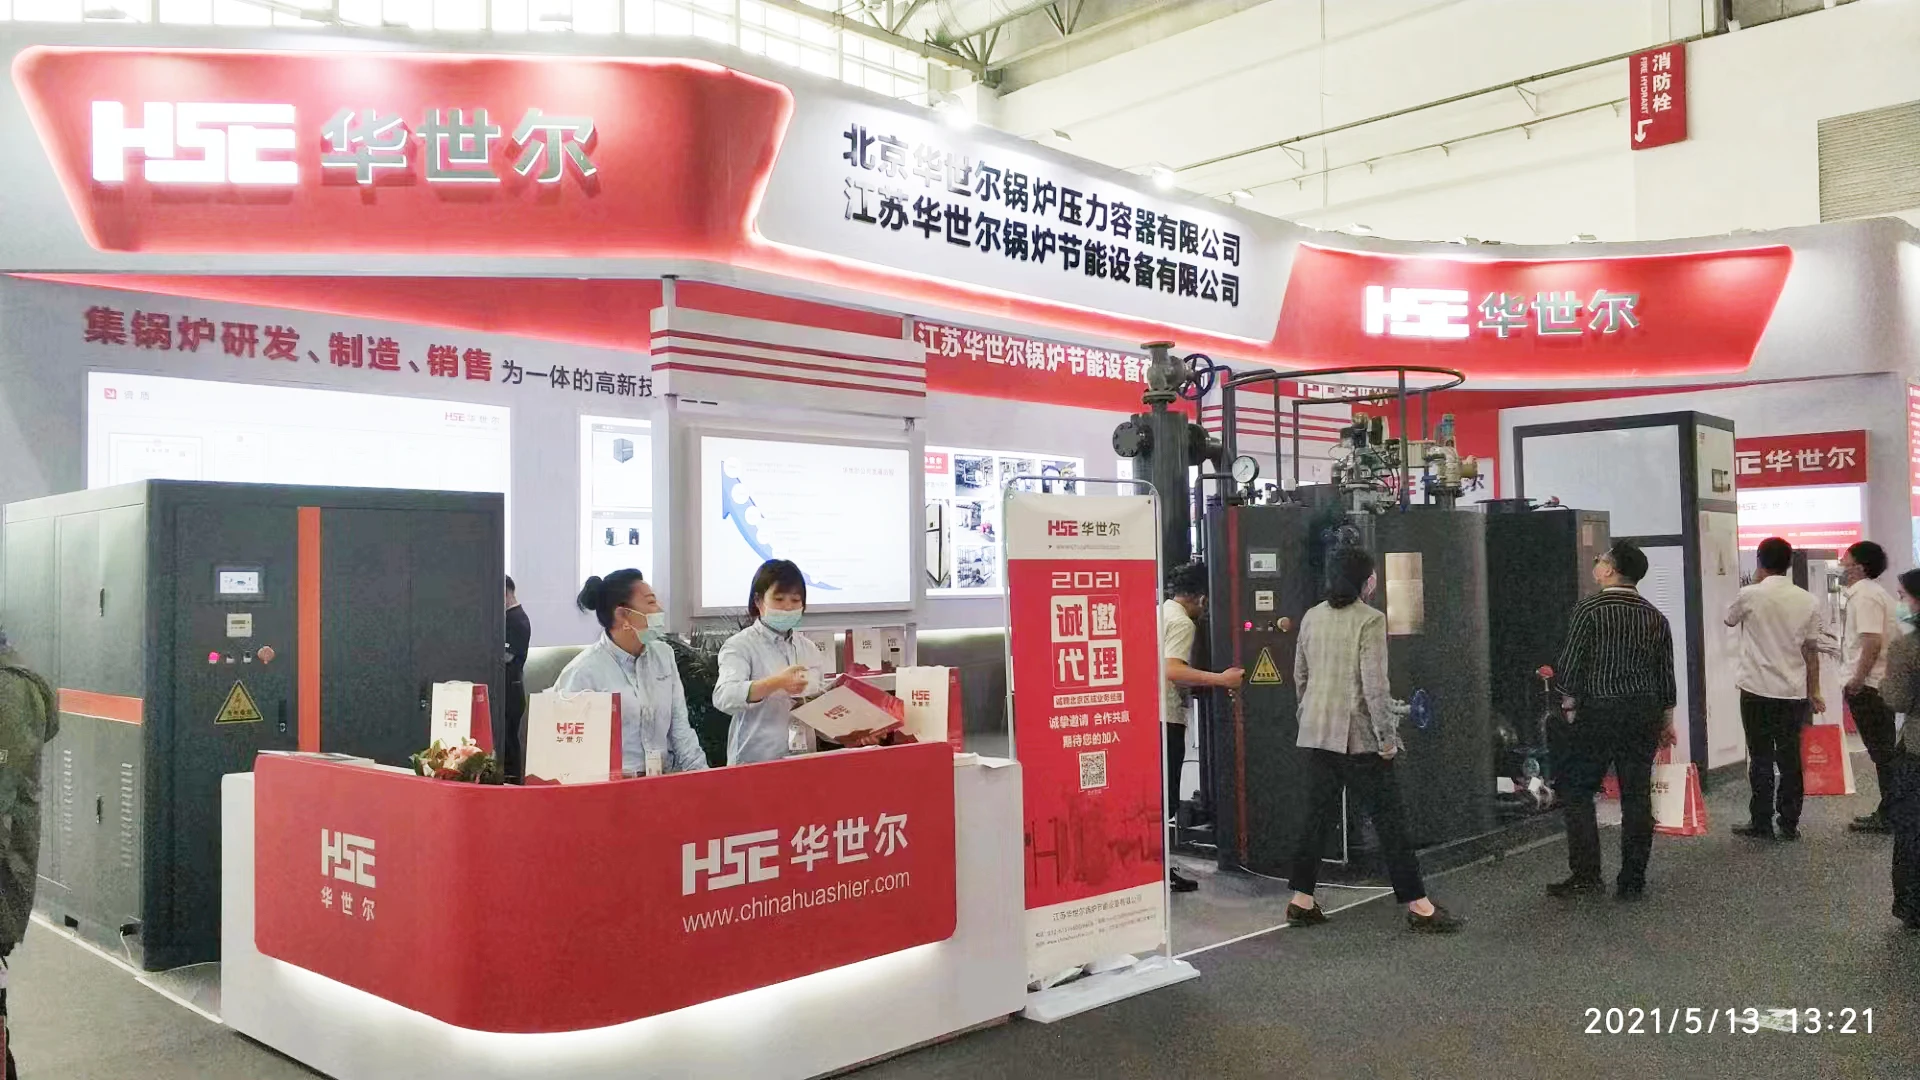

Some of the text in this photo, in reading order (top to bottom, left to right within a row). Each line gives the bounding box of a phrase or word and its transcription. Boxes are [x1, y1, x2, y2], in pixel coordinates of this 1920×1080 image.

[1640, 56, 1649, 114] FIRE HYDRANT
[1652, 51, 1672, 113] 消防栓
[91, 100, 597, 185] HSE 华世尔
[843, 122, 1241, 268] 北京华世尔锅炉压力容器有限公司
[843, 175, 1240, 308] 江苏华世尔锅炉节能设备有限公司
[1477, 289, 1641, 338] 华世尔
[83, 305, 493, 382] 集锅炉研发、制造、销售
[1765, 446, 1857, 473] 华世尔
[1048, 520, 1121, 537] HSE 华世尔
[1051, 571, 1120, 589] 2021
[1057, 646, 1119, 683] 代理
[912, 690, 930, 700] HSE
[1049, 709, 1130, 729] 诚挚邀请 合作共赢
[556, 722, 585, 735] HSE
[1063, 731, 1120, 748] 期待您的加入
[321, 827, 376, 889] HSE
[681, 812, 909, 897] HSE 华世尔
[320, 885, 376, 922] 华世尔
[682, 871, 911, 933] www.chinahuashier.com
